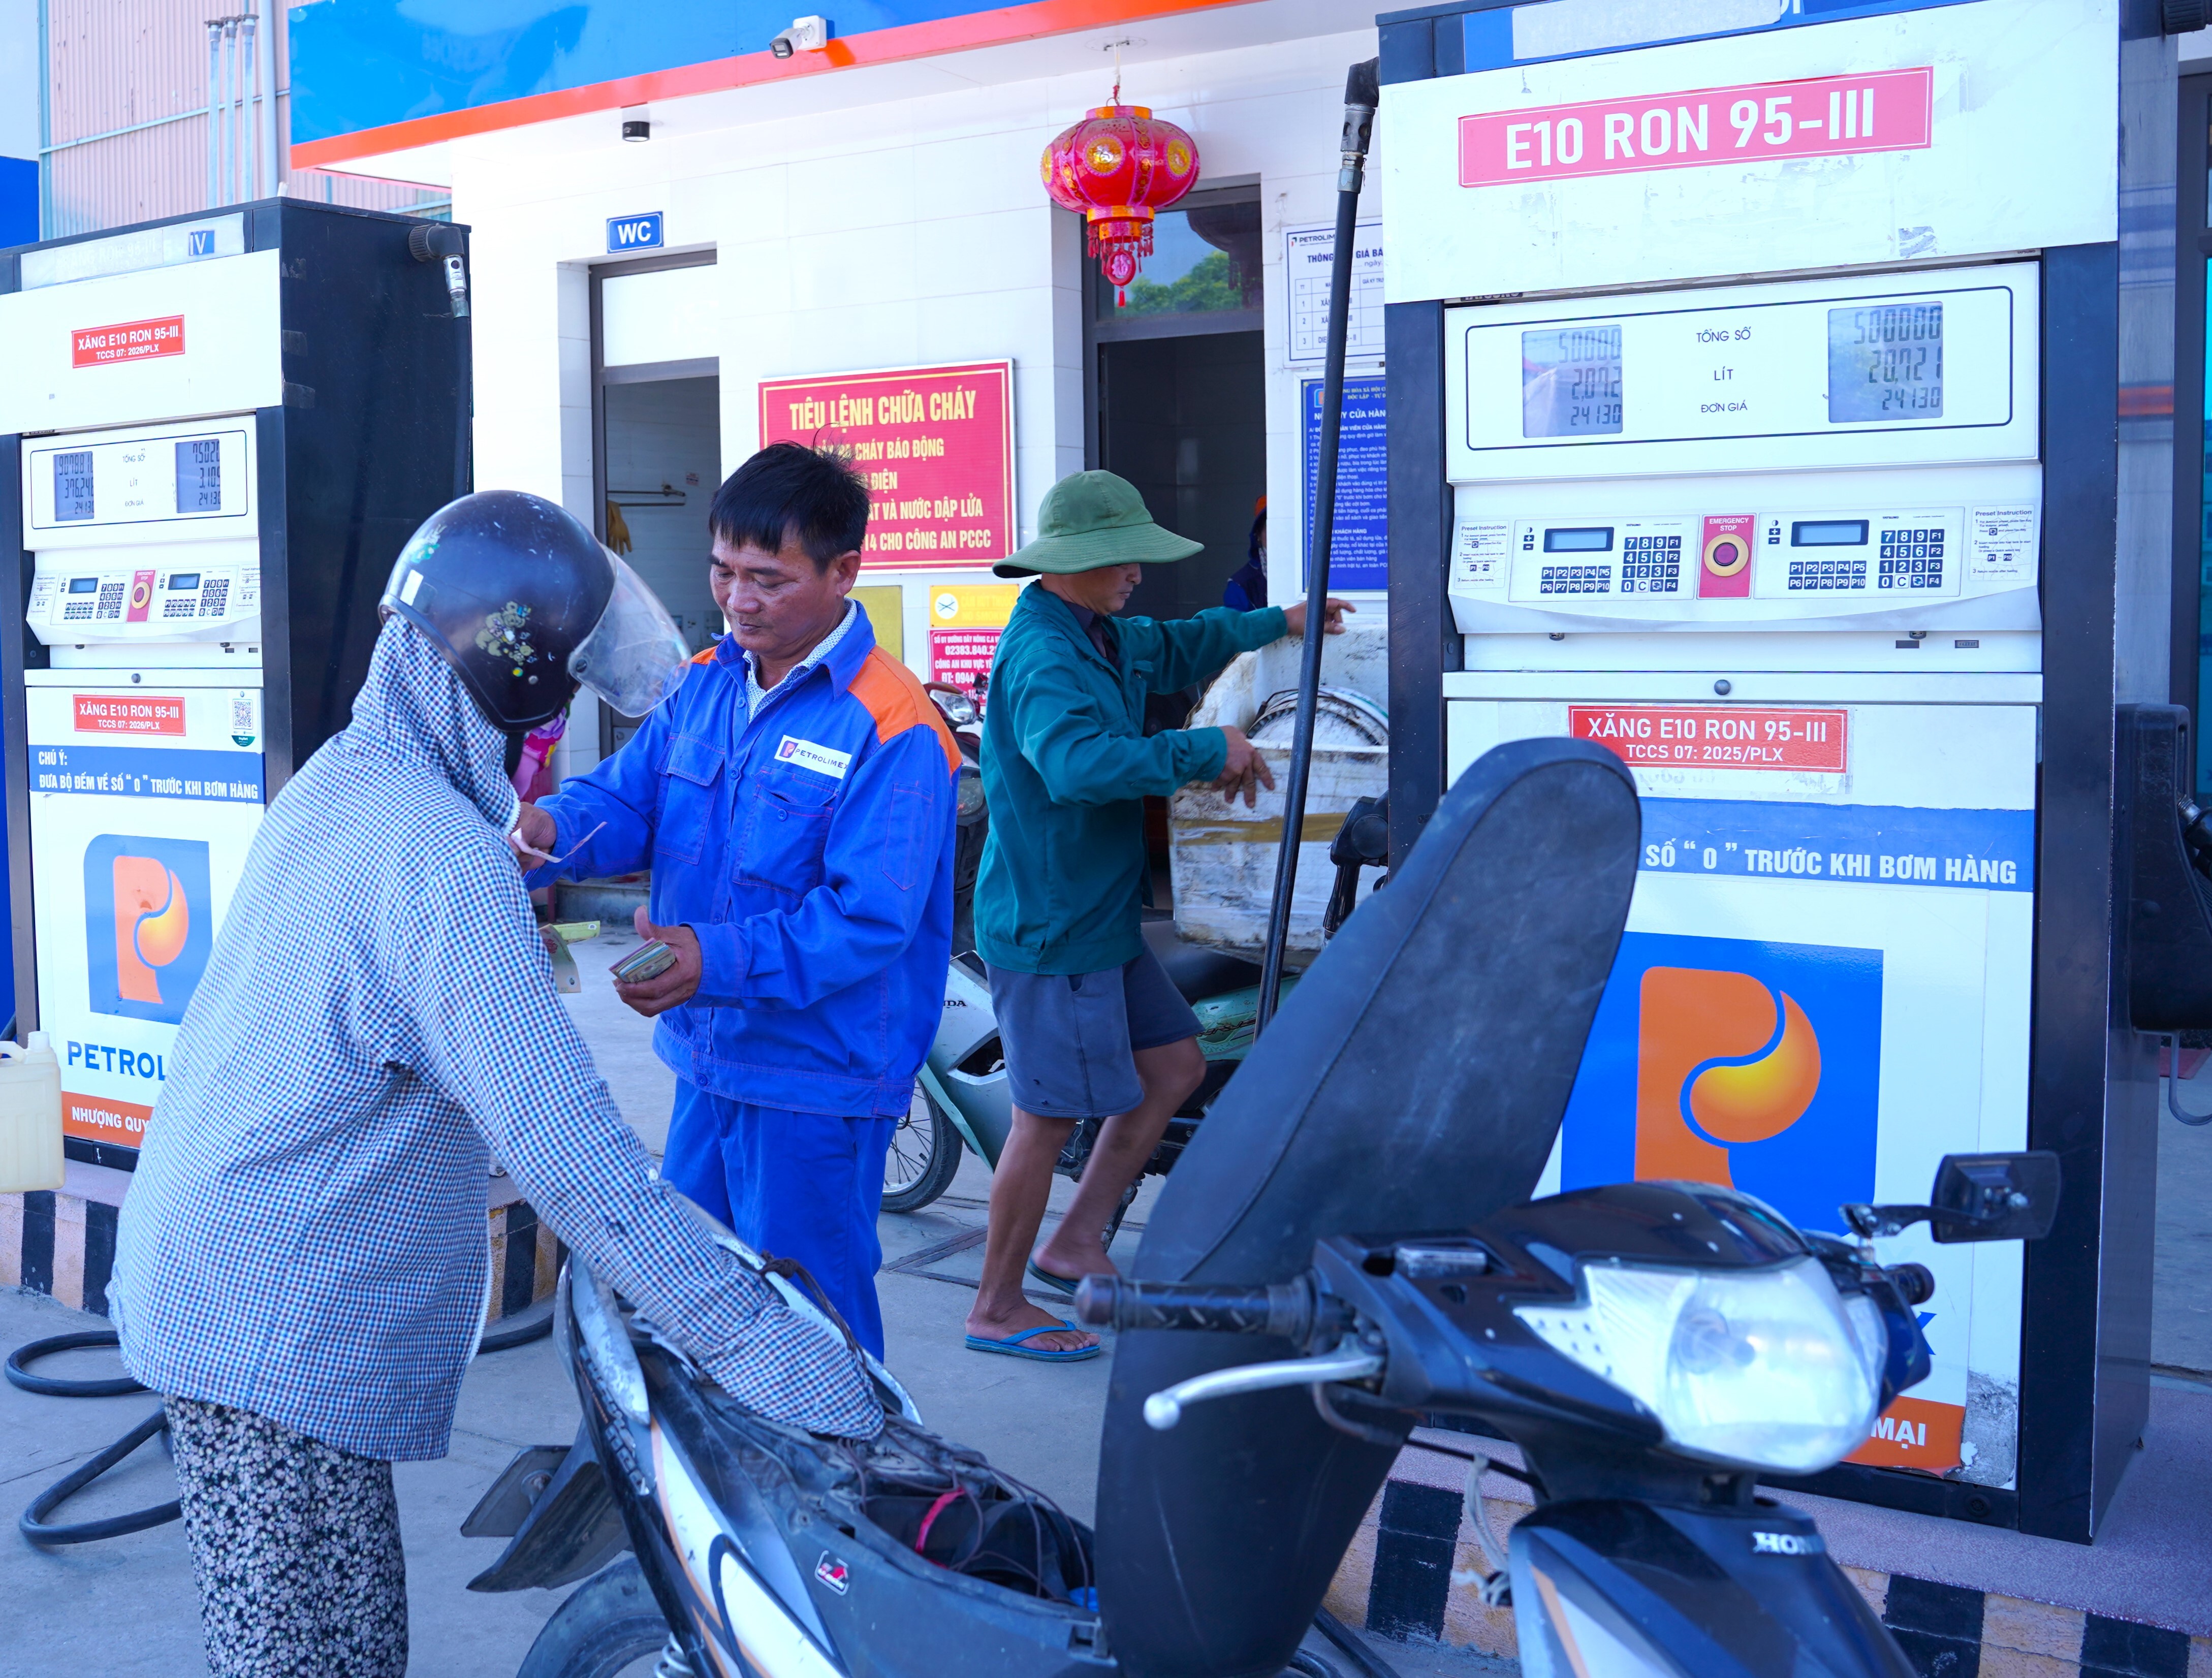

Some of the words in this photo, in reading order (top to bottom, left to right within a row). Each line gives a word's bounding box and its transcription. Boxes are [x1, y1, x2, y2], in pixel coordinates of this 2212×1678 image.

[1506, 117, 1583, 171] E10
[1604, 104, 1709, 160] RON
[1729, 88, 1875, 147] 95-III
[618, 221, 651, 244] WC
[1300, 234, 1335, 242] PETROLIM
[1307, 252, 1334, 263] THÔNG
[1356, 248, 1370, 258] GIÁ
[1372, 247, 1383, 257] BÁ
[1696, 329, 1729, 342] TỔNG
[1735, 326, 1751, 340] SỐ
[1854, 306, 1941, 344] 500000
[78, 334, 106, 351] XĂNG
[109, 334, 127, 346] E10
[130, 329, 151, 343] RON
[154, 325, 178, 340] 95-III
[1559, 329, 1621, 363] 50000
[96, 351, 115, 360] TCCS
[116, 349, 127, 358] 07:
[128, 343, 159, 356] 2026/PLX
[1714, 366, 1733, 381] LÍT
[1869, 346, 1941, 384] 20,721
[1572, 366, 1622, 401] 2,072
[789, 397, 825, 431] TIÊU
[831, 394, 873, 433] LỆNH
[878, 390, 925, 424] CHỮA
[930, 385, 976, 422] CHÁY
[1701, 403, 1725, 413] ĐƠN
[1728, 400, 1748, 411] GIÁ
[1883, 387, 1940, 410] 24130
[1368, 408, 1386, 418] HÀN
[1571, 404, 1621, 426] 24130
[855, 438, 882, 461] CHÁY
[887, 437, 909, 459] BÁO
[912, 435, 944, 461] ĐỘNG
[871, 468, 898, 494] ĐIỆN
[882, 498, 897, 521] VÀ
[900, 498, 931, 519] NƯỚC
[934, 496, 958, 522] DẬP
[961, 493, 983, 517] LỬA
[880, 532, 902, 550] CHO
[905, 528, 937, 549] CÔNG
[940, 531, 957, 548] AN
[960, 530, 991, 549] PCCC
[1628, 539, 1635, 548] 7
[1642, 539, 1649, 548] 8
[1656, 539, 1663, 547] 9
[1884, 532, 1892, 542] 7
[1901, 532, 1908, 542] 8
[1917, 531, 1924, 541] 9
[1626, 553, 1633, 562] 4
[1641, 553, 1648, 562] 5
[1655, 552, 1662, 562] 6
[1883, 547, 1891, 557] 4
[1900, 547, 1907, 556] 5
[1916, 547, 1923, 556] 6
[1626, 567, 1631, 577] 1
[1639, 567, 1647, 576] 2
[1654, 567, 1661, 576] 3
[1883, 562, 1888, 572] 1
[1899, 562, 1906, 572] 2
[1915, 561, 1922, 571] 3
[935, 658, 950, 669] CÔNG
[951, 659, 960, 669] AN
[960, 659, 972, 669] KHU
[79, 701, 107, 716] XĂNG
[110, 704, 128, 716] E10
[131, 705, 152, 717] RON
[155, 706, 179, 718] 95-III
[98, 719, 116, 728] TCCS
[118, 720, 128, 729] 07:
[129, 721, 160, 730] 2026/PLX
[1587, 712, 1652, 739] XĂNG
[1660, 719, 1697, 739] E10
[1705, 719, 1756, 741] RON
[1764, 721, 1826, 743] 95-III
[39, 749, 56, 765] CHÚ
[59, 749, 68, 766] Ý:
[795, 748, 848, 770] PETROLIMEX
[1626, 744, 1669, 759] TCCS
[1674, 744, 1698, 759] 07:
[1703, 746, 1784, 763] 2025/PLX
[39, 773, 57, 788] ĐƯA
[60, 775, 72, 792] BỘ
[75, 771, 94, 790] ĐẾM
[97, 773, 108, 791] VỀ
[111, 772, 123, 791] SỐ
[151, 777, 182, 795] TRƯỚC
[185, 783, 202, 796] KHI
[204, 781, 228, 797] BƠM
[230, 781, 258, 799] HÀNG
[1645, 837, 1676, 867] SỐ
[1745, 845, 1822, 875] TRƯỚC
[1830, 852, 1871, 877] KHI
[1879, 851, 1936, 880] BƠM
[1945, 853, 2016, 884] HÀNG
[67, 1040, 166, 1081] PETROL
[72, 1106, 122, 1129] NHƯỢNG
[125, 1116, 150, 1133] QUY
[1871, 1416, 1926, 1450] MẠI
